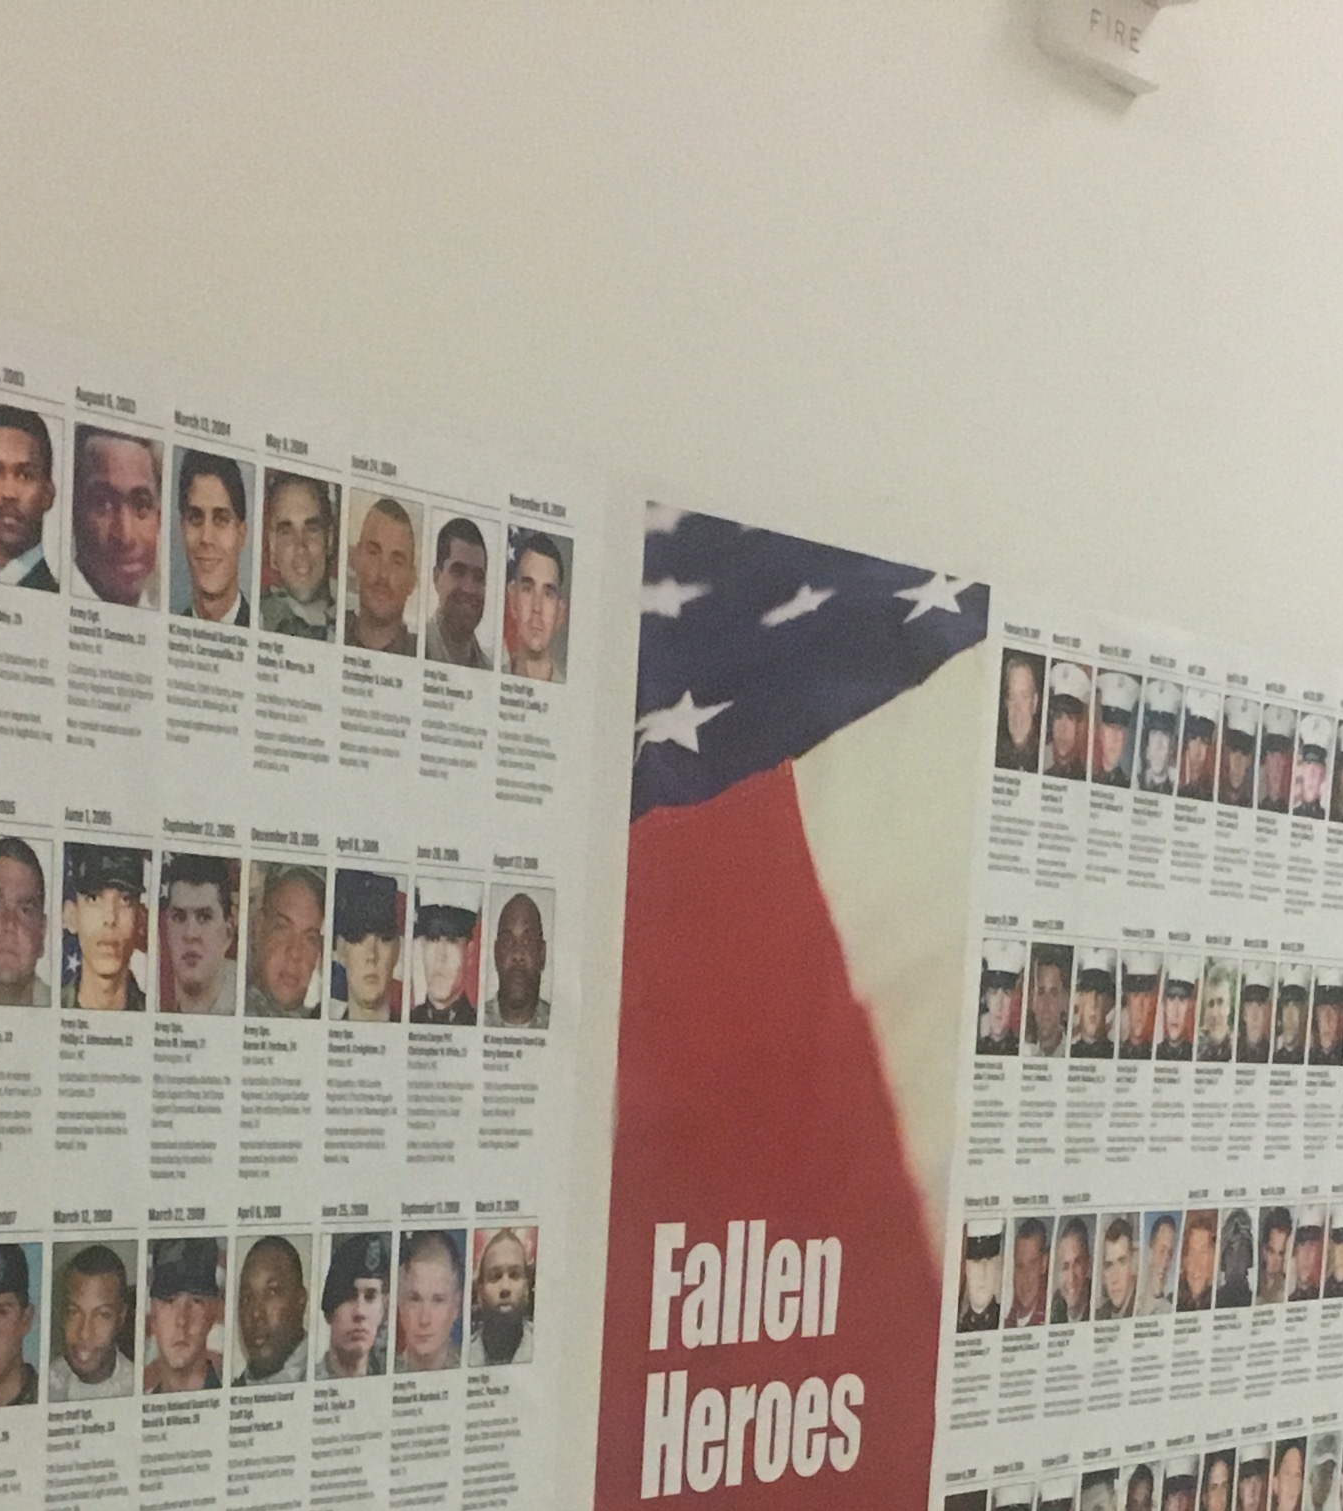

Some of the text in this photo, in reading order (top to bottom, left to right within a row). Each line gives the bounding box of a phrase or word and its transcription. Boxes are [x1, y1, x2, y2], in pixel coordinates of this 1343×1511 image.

[1090, 8, 1142, 54] FIRE
[75, 385, 105, 407] August
[174, 410, 199, 429] March
[265, 433, 281, 453] May
[64, 806, 83, 823] June
[162, 816, 203, 835] September
[54, 1210, 79, 1224] March
[148, 1207, 173, 1222] March
[649, 1218, 843, 1351] Fallen
[640, 1369, 865, 1500] Heroes
